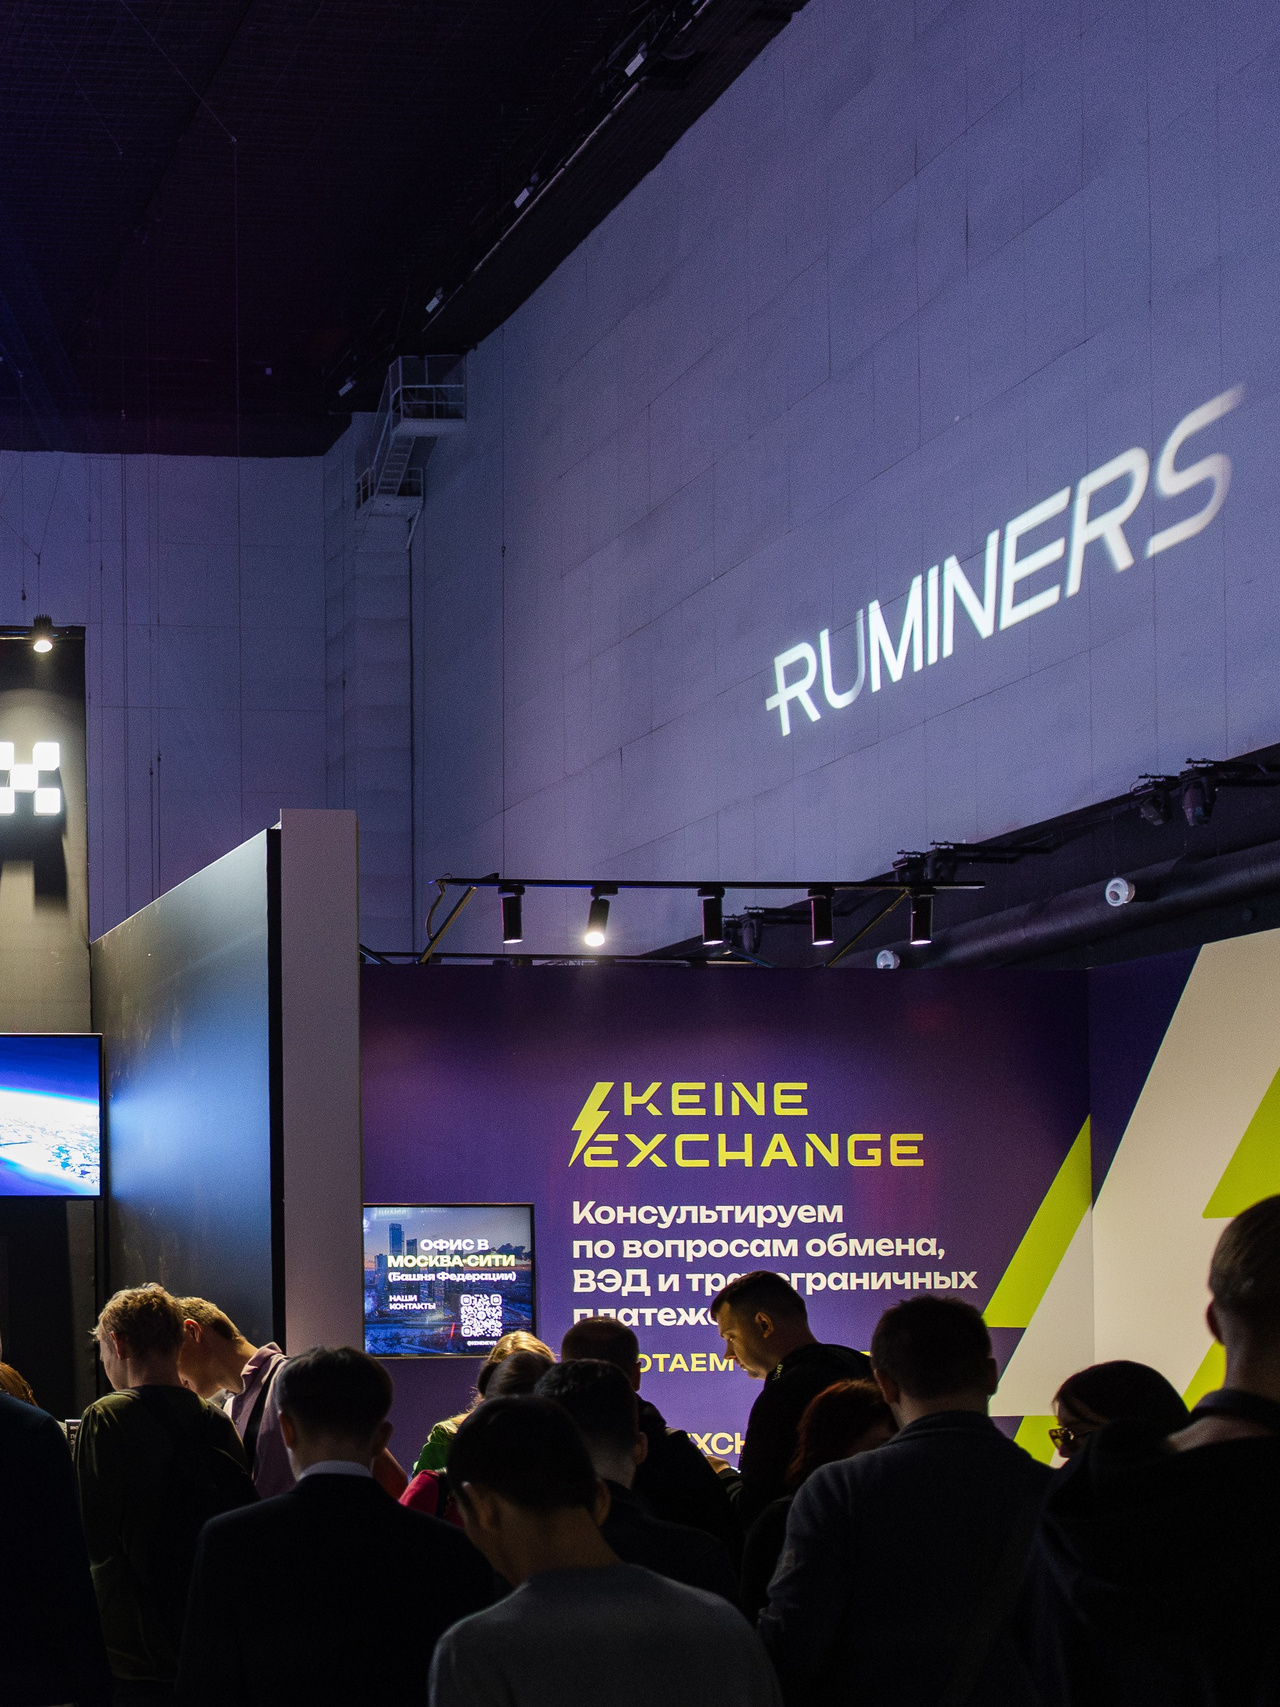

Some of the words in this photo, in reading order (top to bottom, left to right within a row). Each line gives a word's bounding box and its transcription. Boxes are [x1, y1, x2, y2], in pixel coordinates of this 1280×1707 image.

[766, 384, 1245, 736] RUMINERS
[623, 1082, 808, 1116] KEINE
[584, 1133, 924, 1168] EXCHANGE
[572, 1200, 844, 1229] Консультируем
[420, 1238, 474, 1251] ОФИС
[477, 1239, 490, 1250] В
[572, 1238, 616, 1259] по
[623, 1237, 799, 1262] вопросам
[806, 1232, 946, 1261] обмена,
[388, 1271, 435, 1283] (Башня
[437, 1271, 517, 1282] Федерации)
[573, 1269, 651, 1297] ВЭД
[658, 1273, 680, 1292] и
[389, 1294, 417, 1302] НАШИ
[389, 1302, 436, 1310] КОНТАКТЫ
